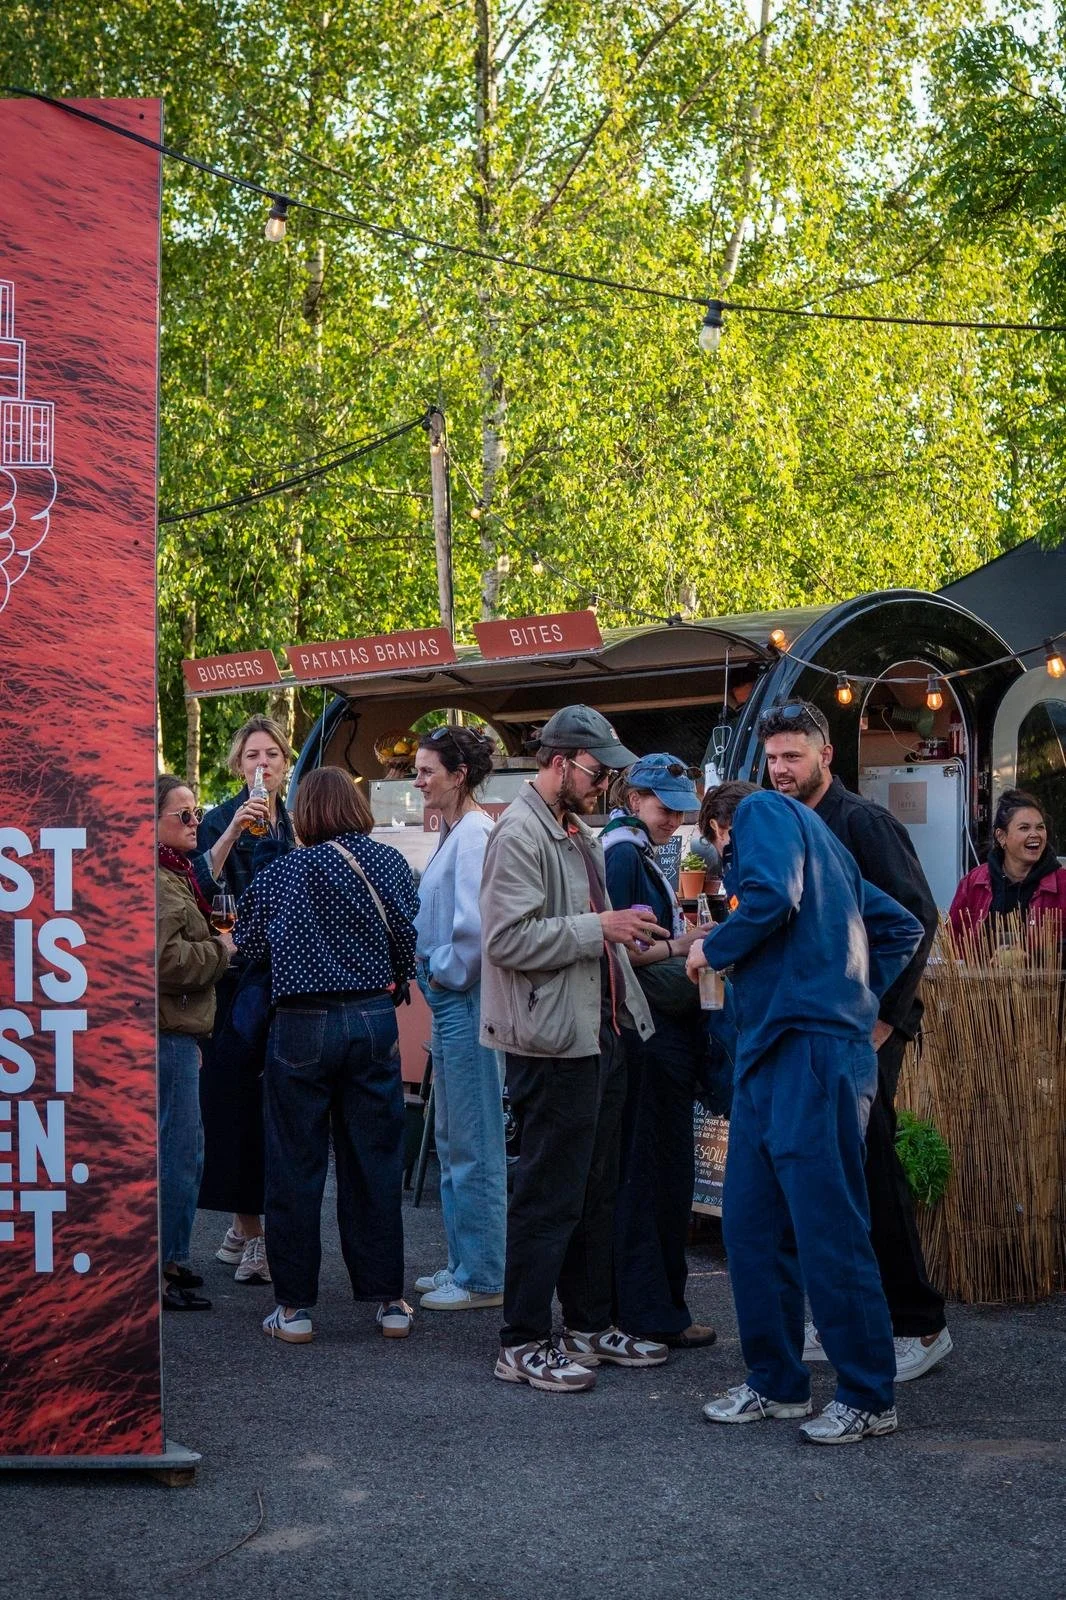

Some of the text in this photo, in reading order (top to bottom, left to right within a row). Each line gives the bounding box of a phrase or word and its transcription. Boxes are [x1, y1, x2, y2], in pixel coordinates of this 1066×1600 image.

[509, 624, 563, 646] BITES
[300, 638, 441, 670] PATATAS BRAVAS
[197, 659, 264, 683] BURGERS
[14, 918, 88, 1003] IS
